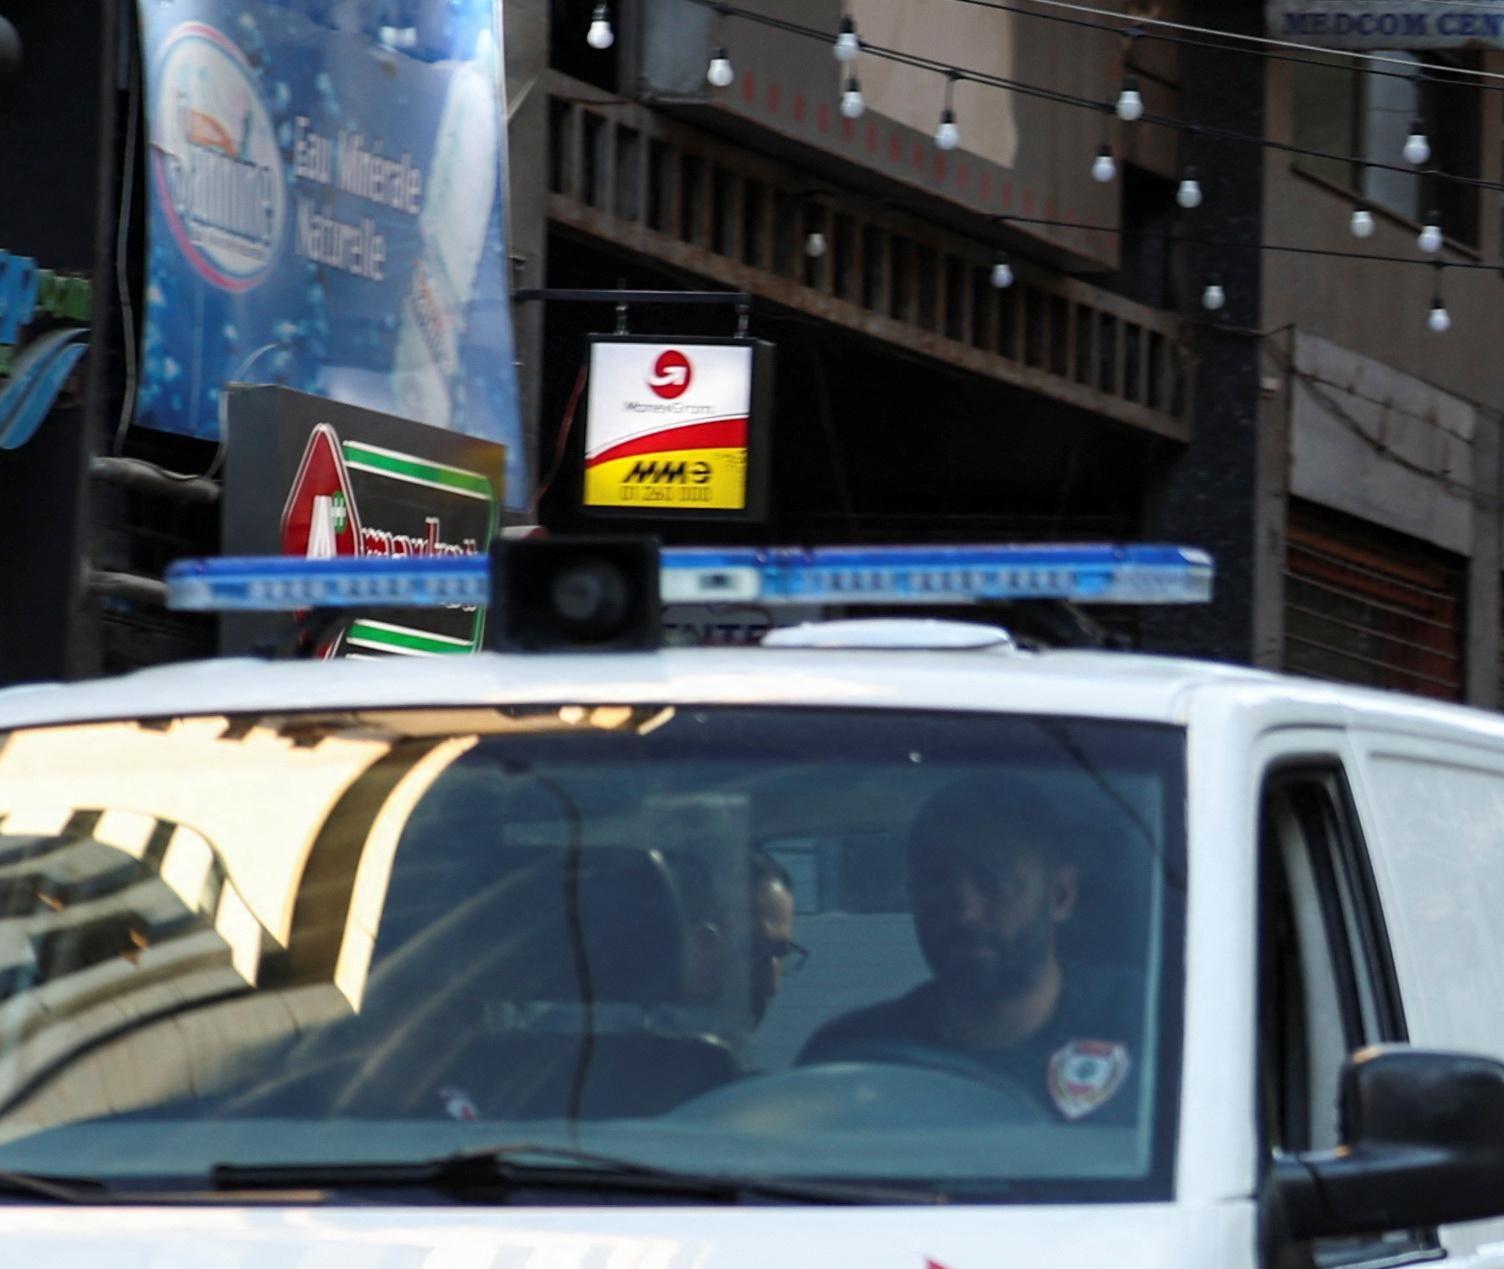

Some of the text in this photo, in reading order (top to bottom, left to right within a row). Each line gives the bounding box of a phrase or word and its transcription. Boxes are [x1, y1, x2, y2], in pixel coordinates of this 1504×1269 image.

[1284, 12, 1426, 37] MEDCOM
[294, 114, 333, 186] Eau
[294, 194, 386, 283] Naturelle
